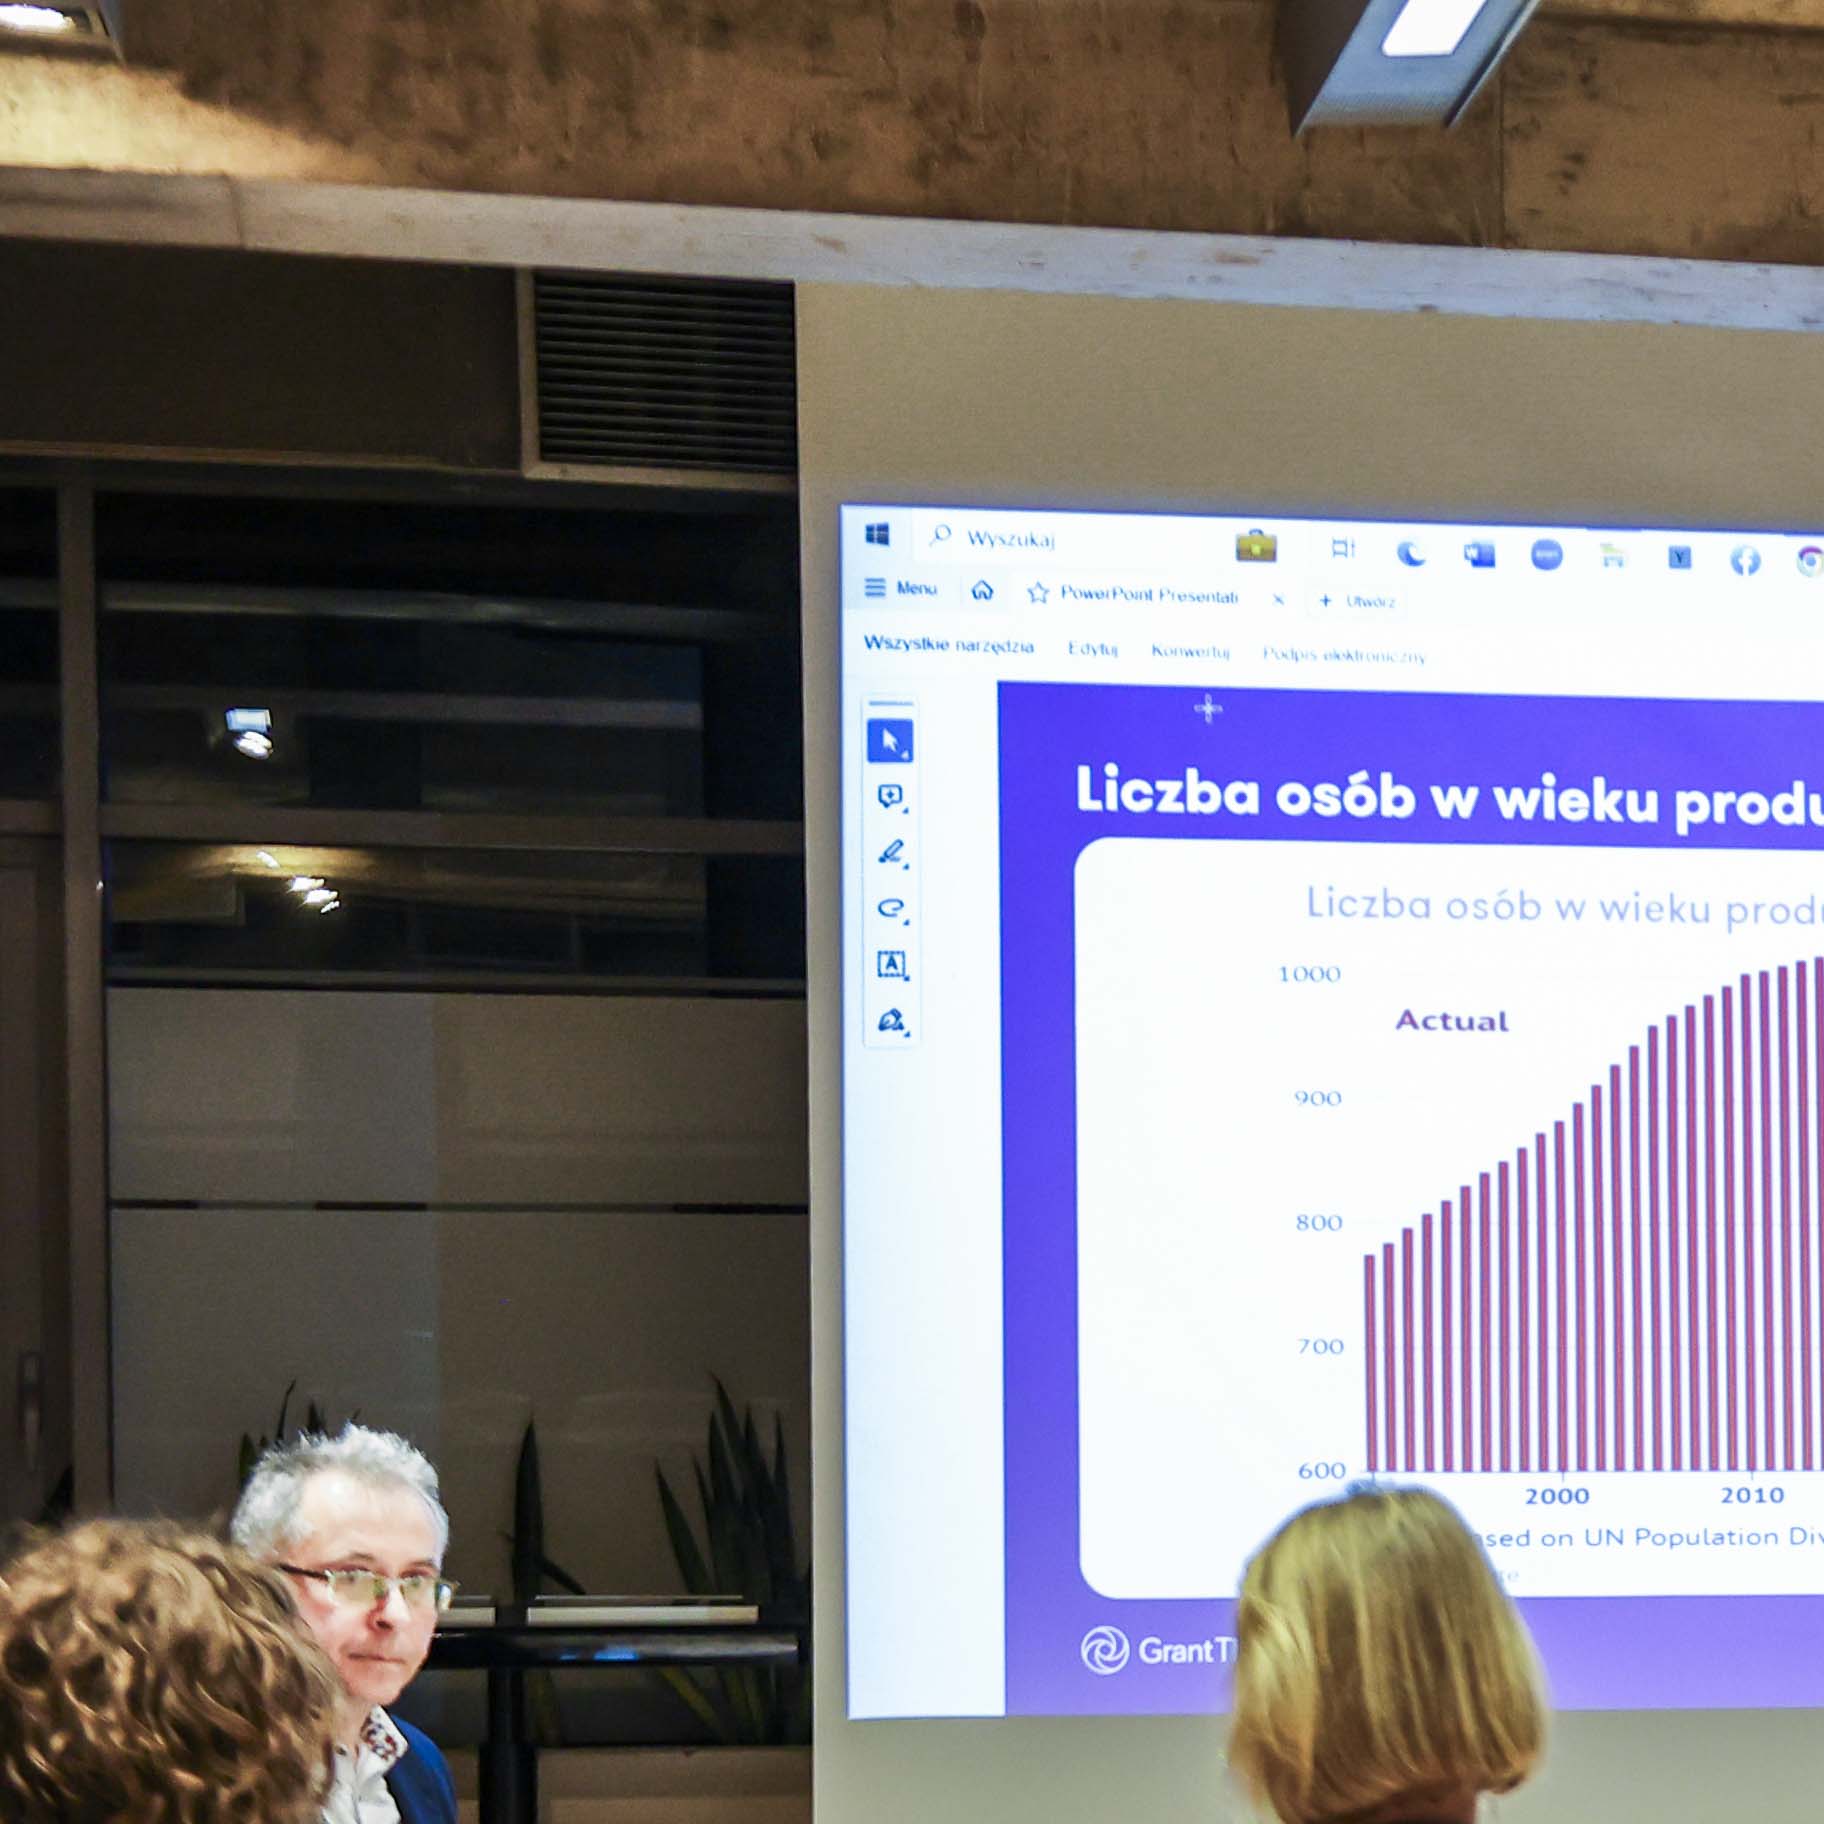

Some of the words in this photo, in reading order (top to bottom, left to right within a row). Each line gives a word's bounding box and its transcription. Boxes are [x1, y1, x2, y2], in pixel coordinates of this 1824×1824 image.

[967, 530, 1055, 550] Wyszukaj
[896, 580, 938, 596] Menu
[1061, 584, 1153, 602] PowerPoint
[863, 634, 950, 652] Wszystkie
[955, 639, 1035, 656] narzędzia
[1077, 762, 1260, 815] Liczba
[1276, 769, 1416, 819] osób
[1429, 785, 1480, 820] w
[1492, 771, 1659, 823] wieku
[1308, 885, 1431, 920] Liczba
[1446, 888, 1542, 921] osób
[1554, 899, 1587, 921] w
[1599, 890, 1710, 924] wieku
[1280, 965, 1342, 983] 1000
[1395, 1008, 1509, 1033] Actual
[1293, 1090, 1343, 1107] 900
[1296, 1214, 1343, 1232] 800
[1299, 1338, 1345, 1355] 700
[1298, 1462, 1347, 1480] 600
[1525, 1487, 1590, 1505] 2000
[1721, 1486, 1785, 1504] 2010
[1540, 1533, 1574, 1548] on
[1585, 1528, 1624, 1547] UN
[1635, 1527, 1779, 1550] Population
